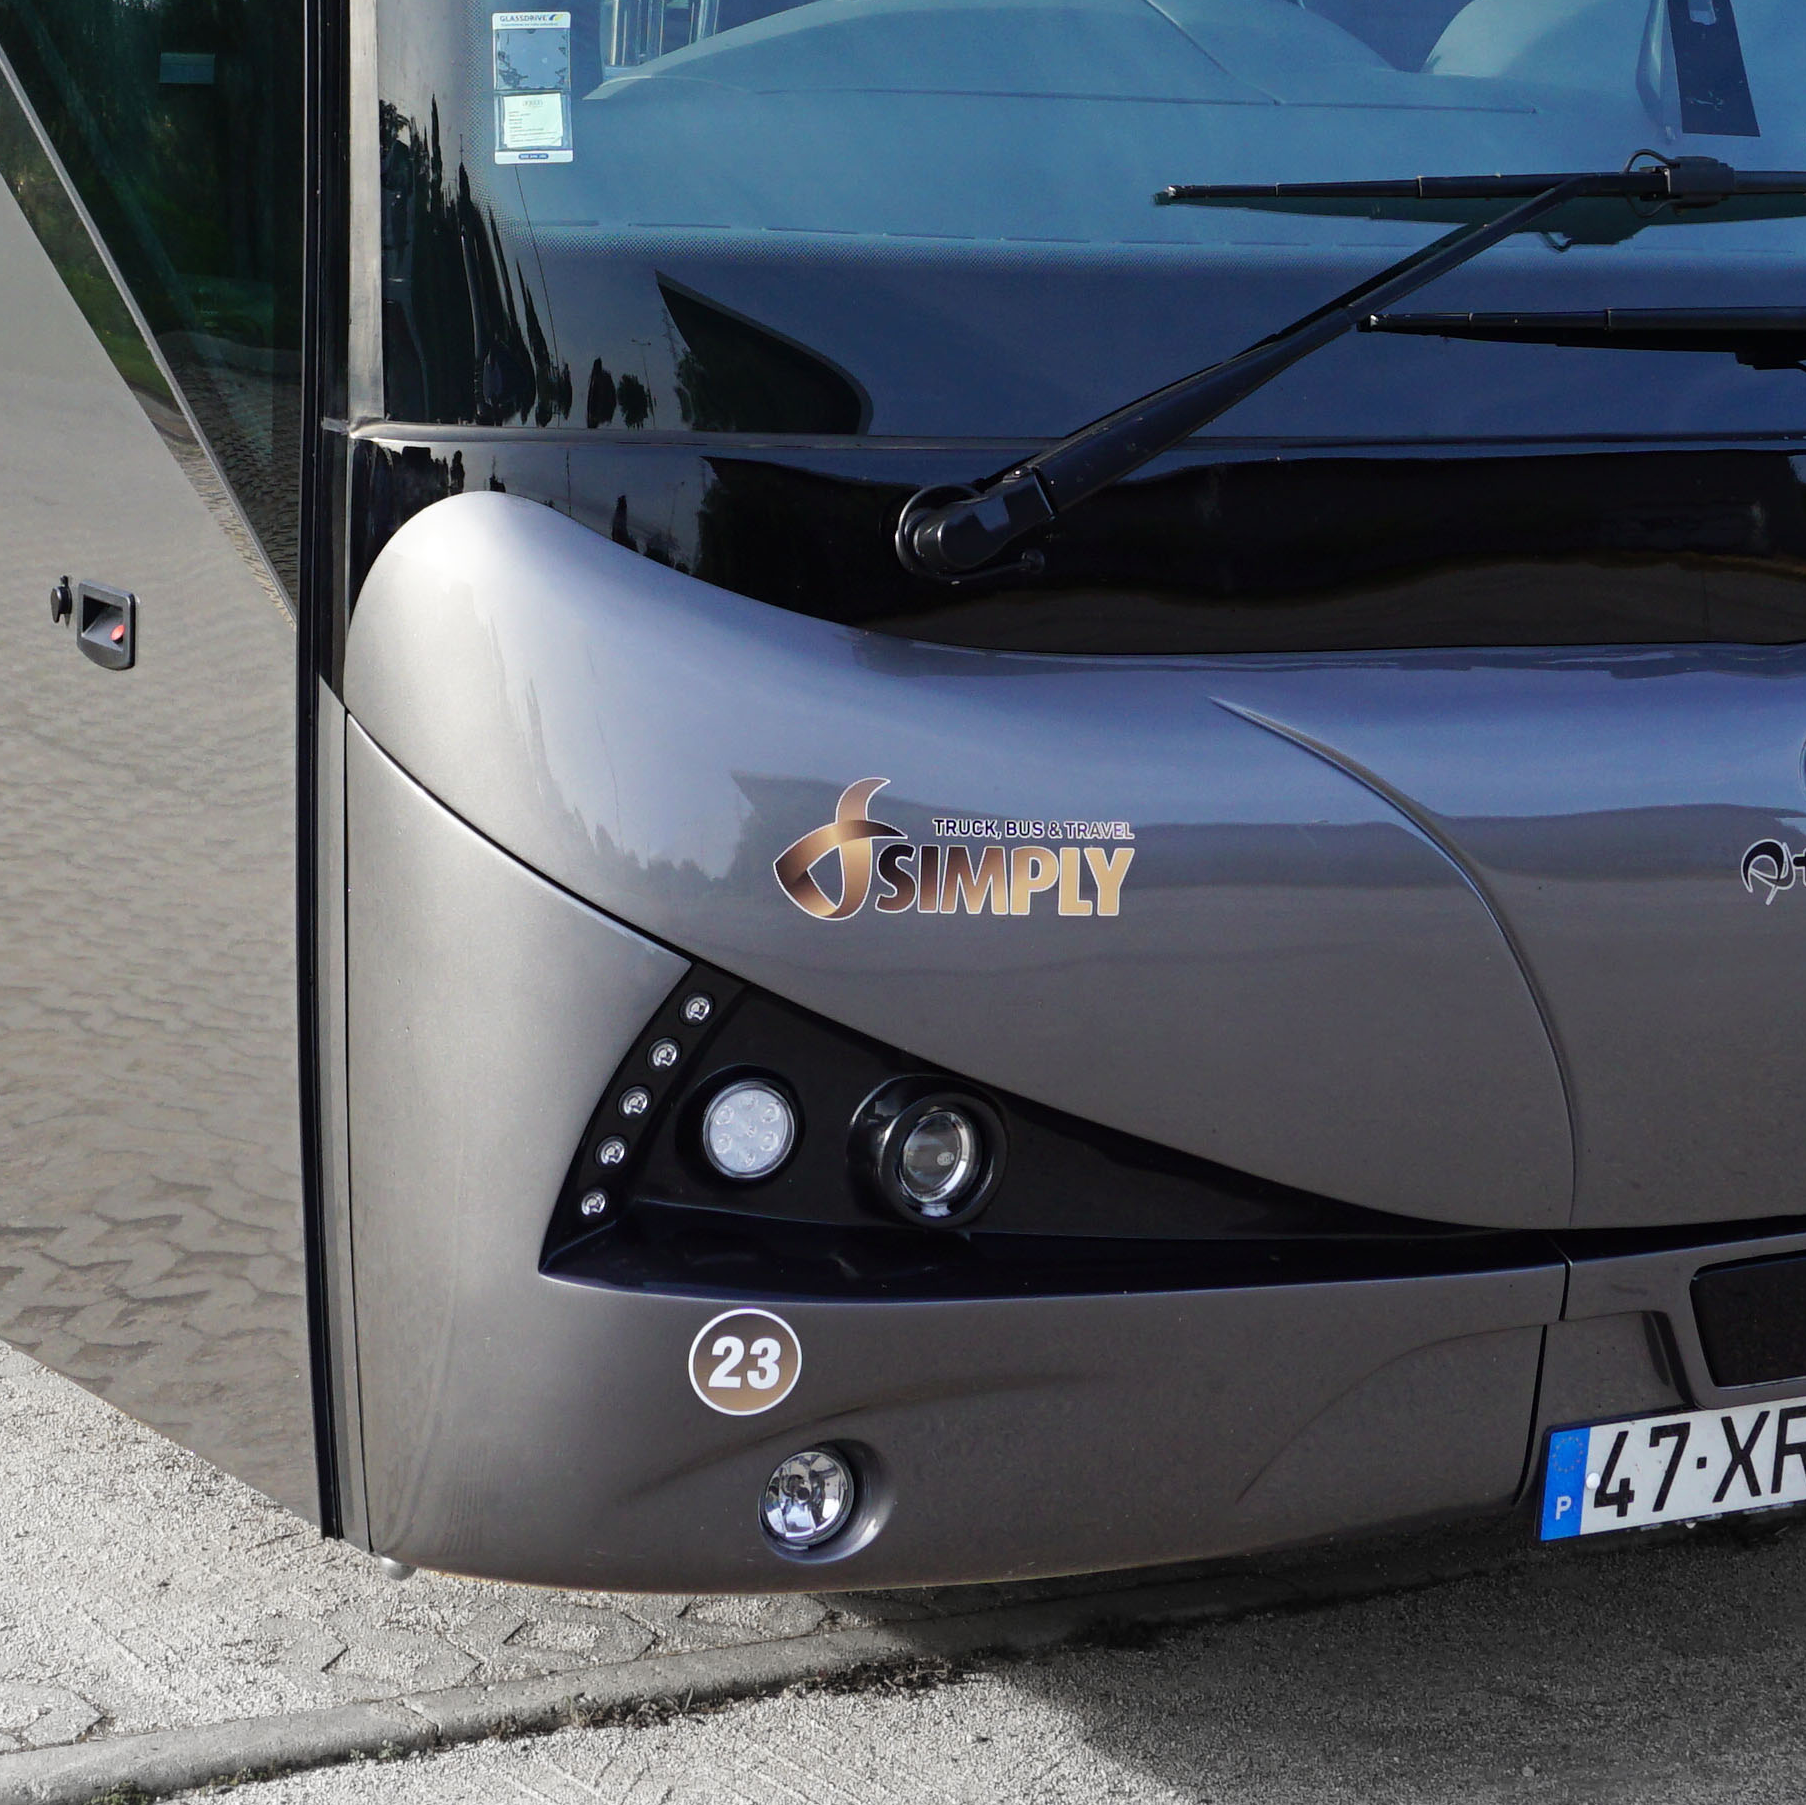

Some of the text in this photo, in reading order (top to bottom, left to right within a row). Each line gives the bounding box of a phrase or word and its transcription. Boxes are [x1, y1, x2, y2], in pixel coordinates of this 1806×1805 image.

[933, 818, 1135, 840] TRUCK, BUS & TRAVEL
[875, 843, 1135, 916] SIMPLY
[707, 1335, 781, 1390] 23
[1554, 1495, 1572, 1520] P
